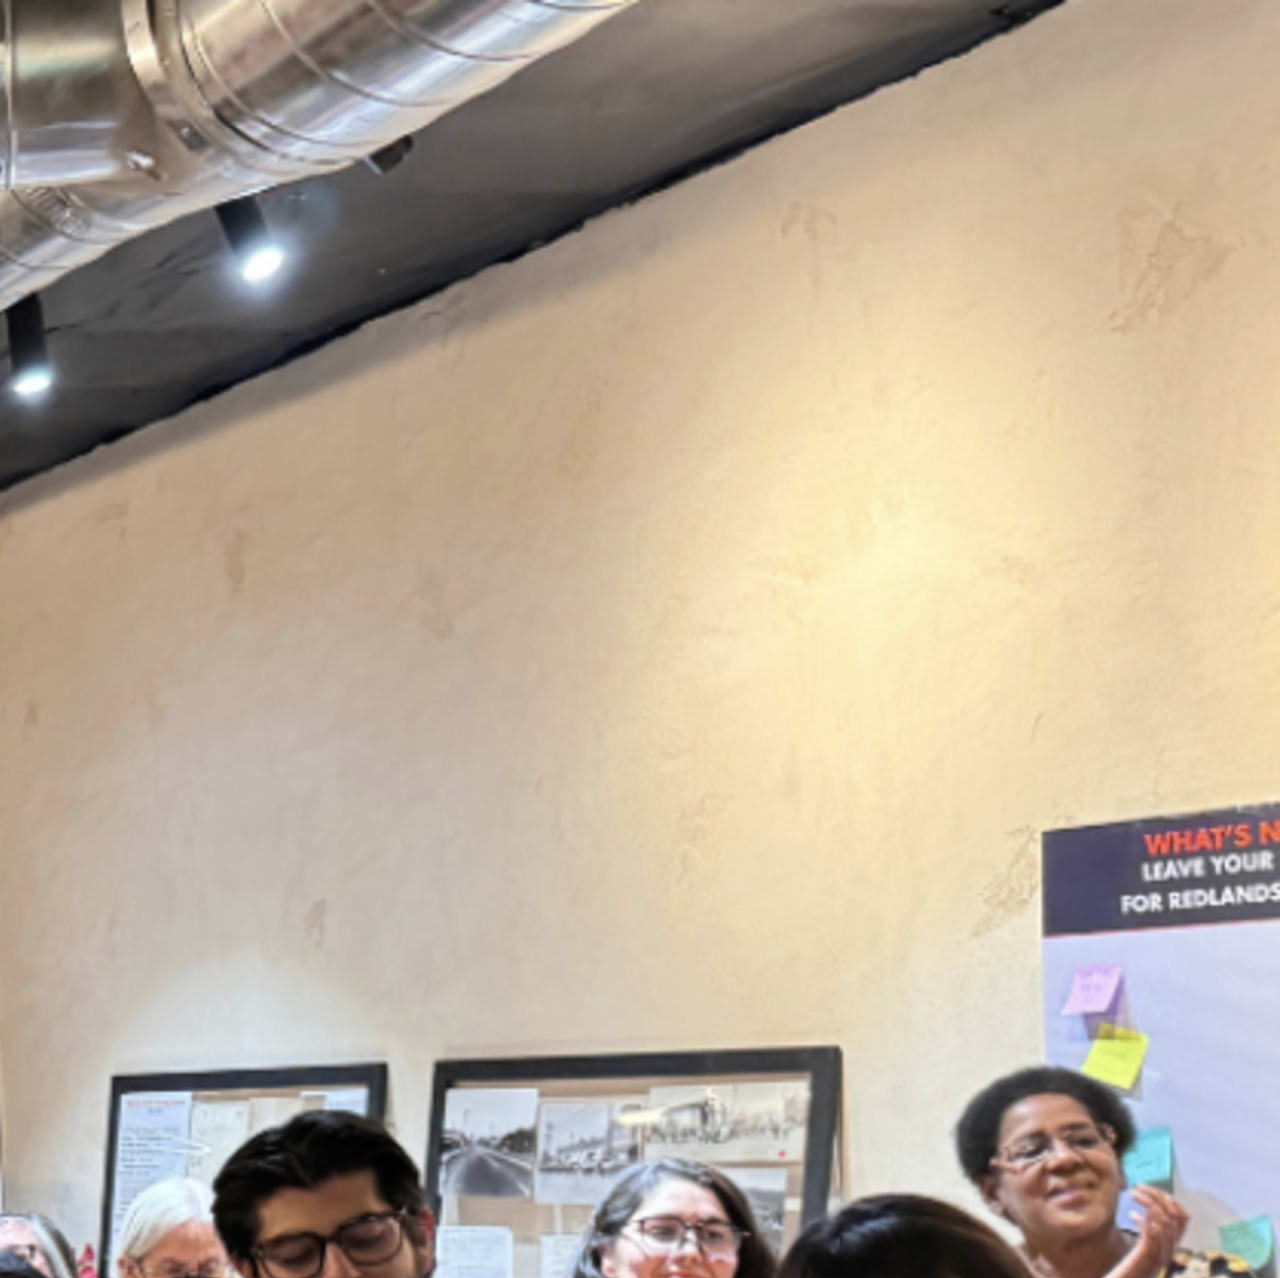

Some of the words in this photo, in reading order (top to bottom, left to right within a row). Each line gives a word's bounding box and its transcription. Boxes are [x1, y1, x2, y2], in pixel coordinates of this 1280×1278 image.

[1144, 824, 1253, 857] WHAT'S
[1141, 856, 1206, 882] LEAVE
[1210, 849, 1275, 875] YOUR
[1119, 892, 1163, 915] FOR
[1168, 881, 1280, 910] REDLANDS
